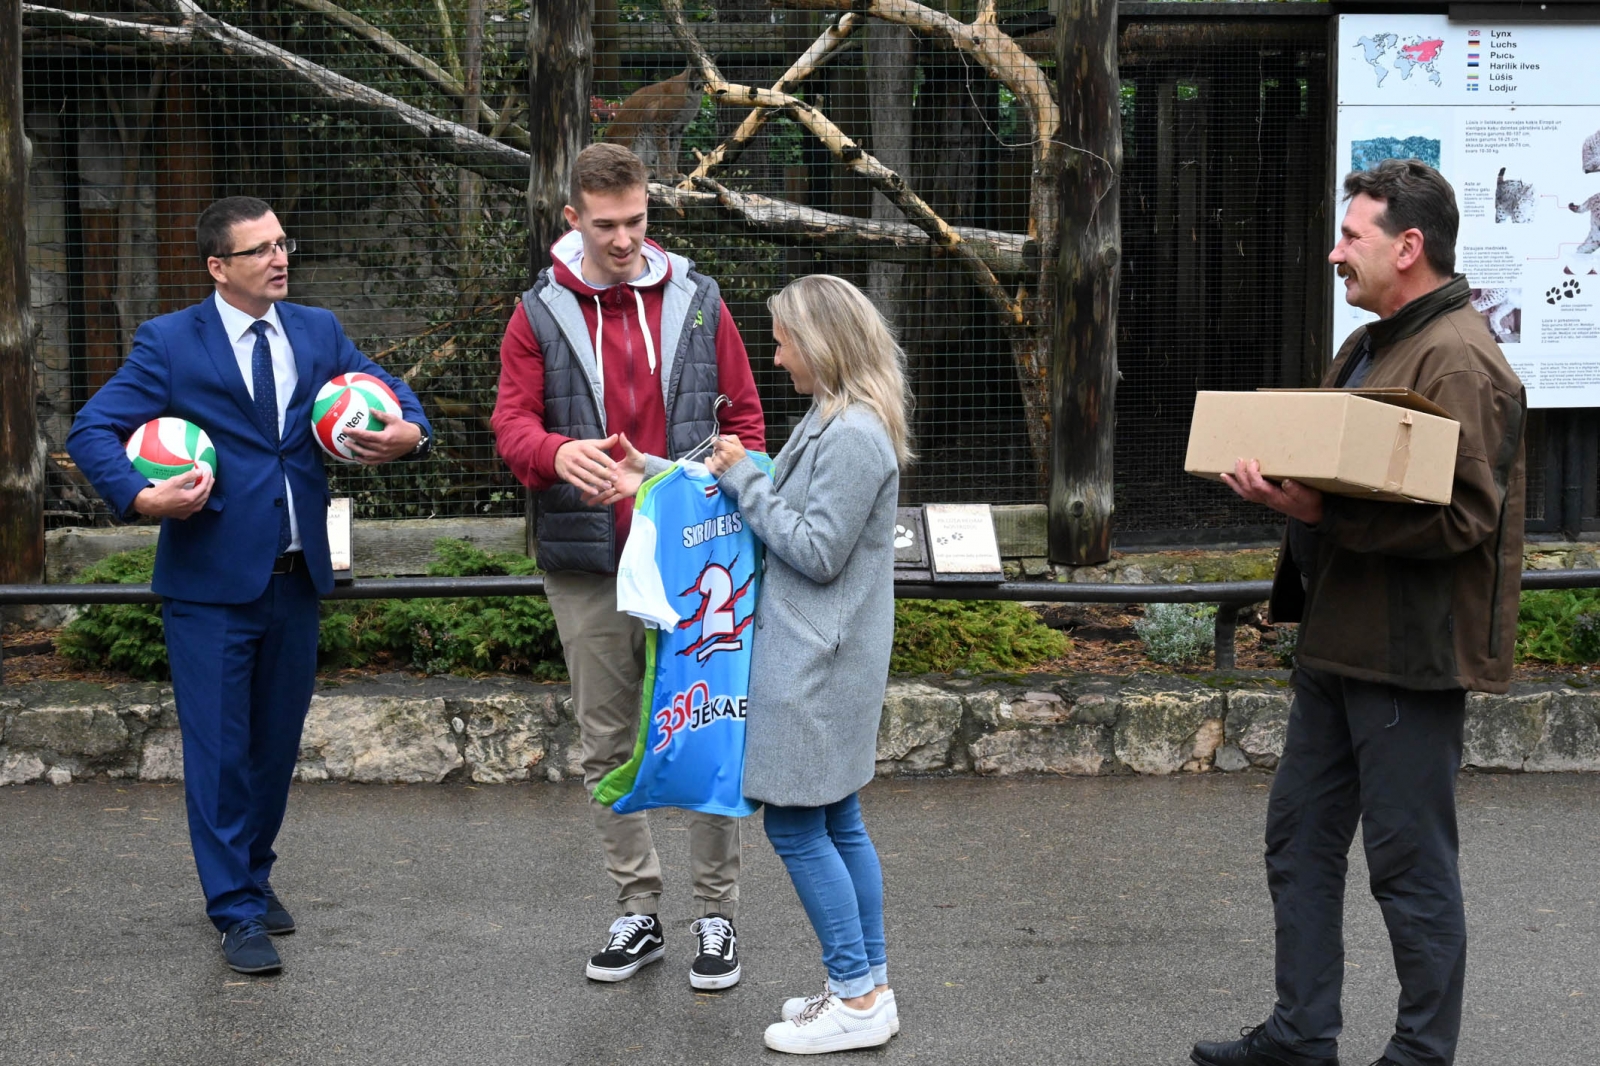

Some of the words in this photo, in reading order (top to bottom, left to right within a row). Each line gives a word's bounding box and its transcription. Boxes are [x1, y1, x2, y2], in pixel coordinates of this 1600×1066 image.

[1490, 29, 1512, 39] Lynx
[1490, 40, 1517, 48] Luchs
[1490, 51, 1515, 59] Рысь
[1489, 62, 1518, 70] Harilik
[1520, 62, 1540, 70] ilves
[1489, 84, 1518, 93] Lodjur
[336, 410, 365, 444] mlten
[699, 563, 735, 643] 2
[654, 681, 709, 753] 350
